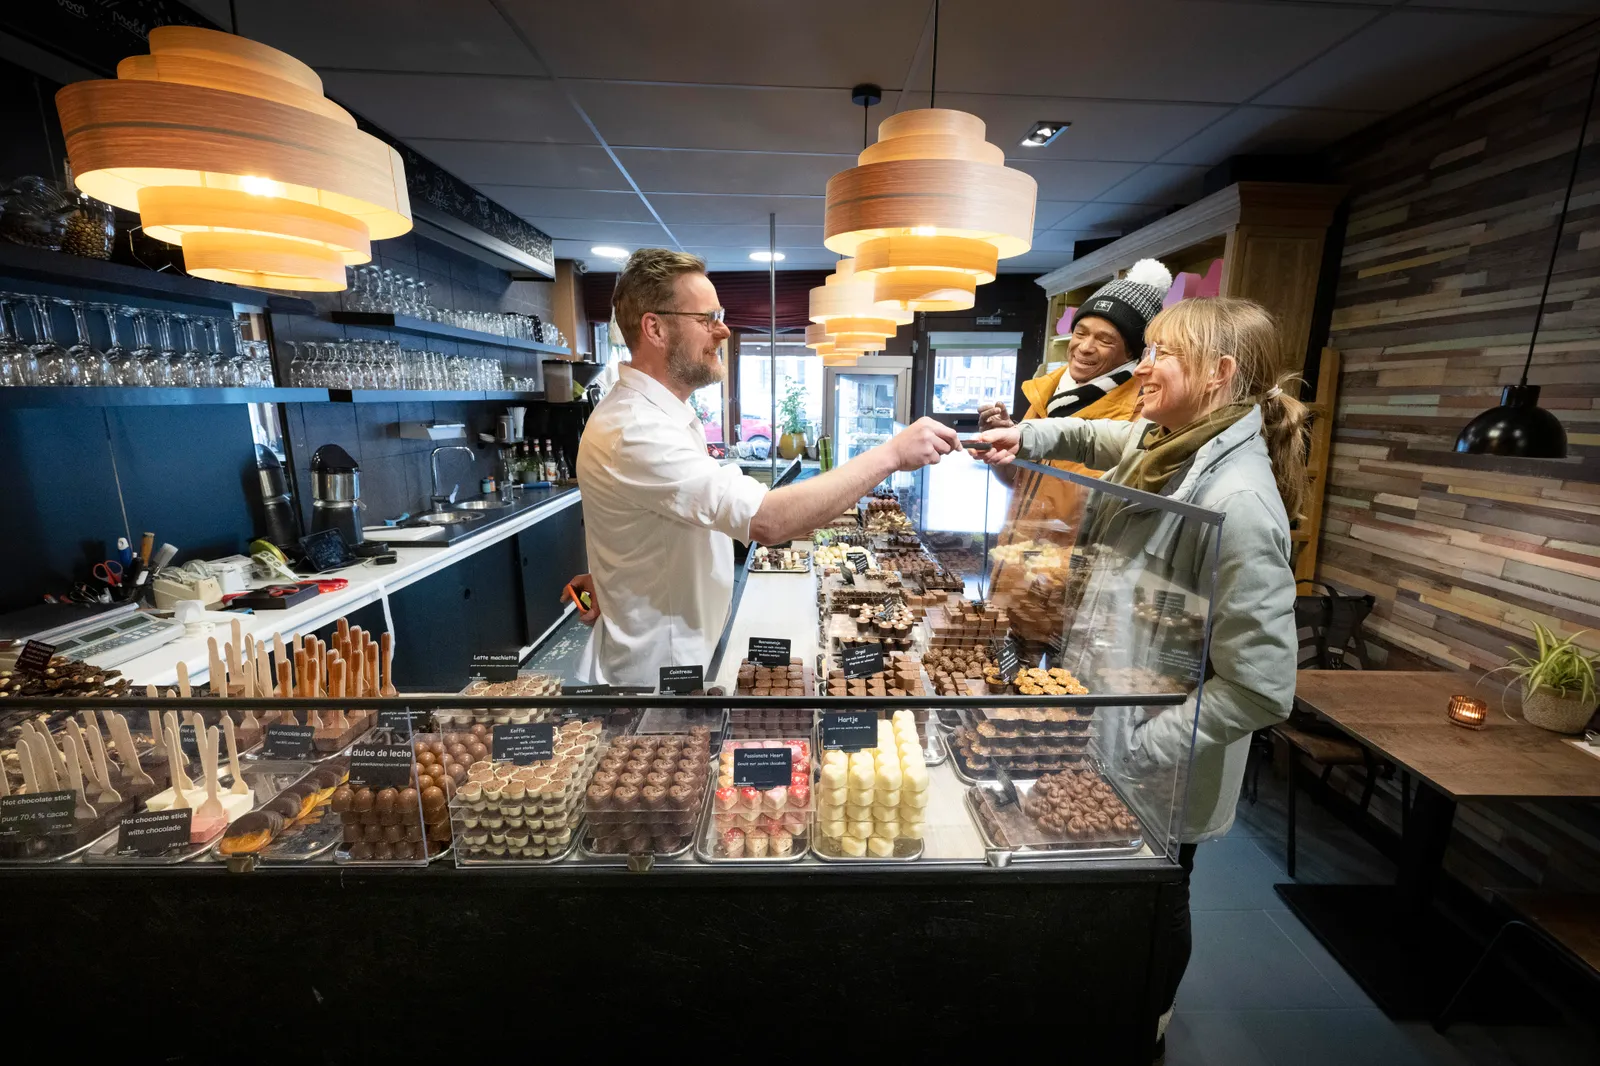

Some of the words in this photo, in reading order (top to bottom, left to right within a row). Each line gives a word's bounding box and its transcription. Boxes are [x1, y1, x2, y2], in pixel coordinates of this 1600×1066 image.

[837, 716, 859, 724] Hartje
[352, 749, 376, 757] dulce
[377, 749, 388, 757] de
[389, 749, 412, 758] leche
[17, 796, 53, 805] chocolate
[1, 815, 18, 824] puur
[135, 815, 169, 824] chocolate
[170, 812, 188, 820] stick
[127, 828, 145, 836] witte
[145, 824, 182, 834] chocolade
